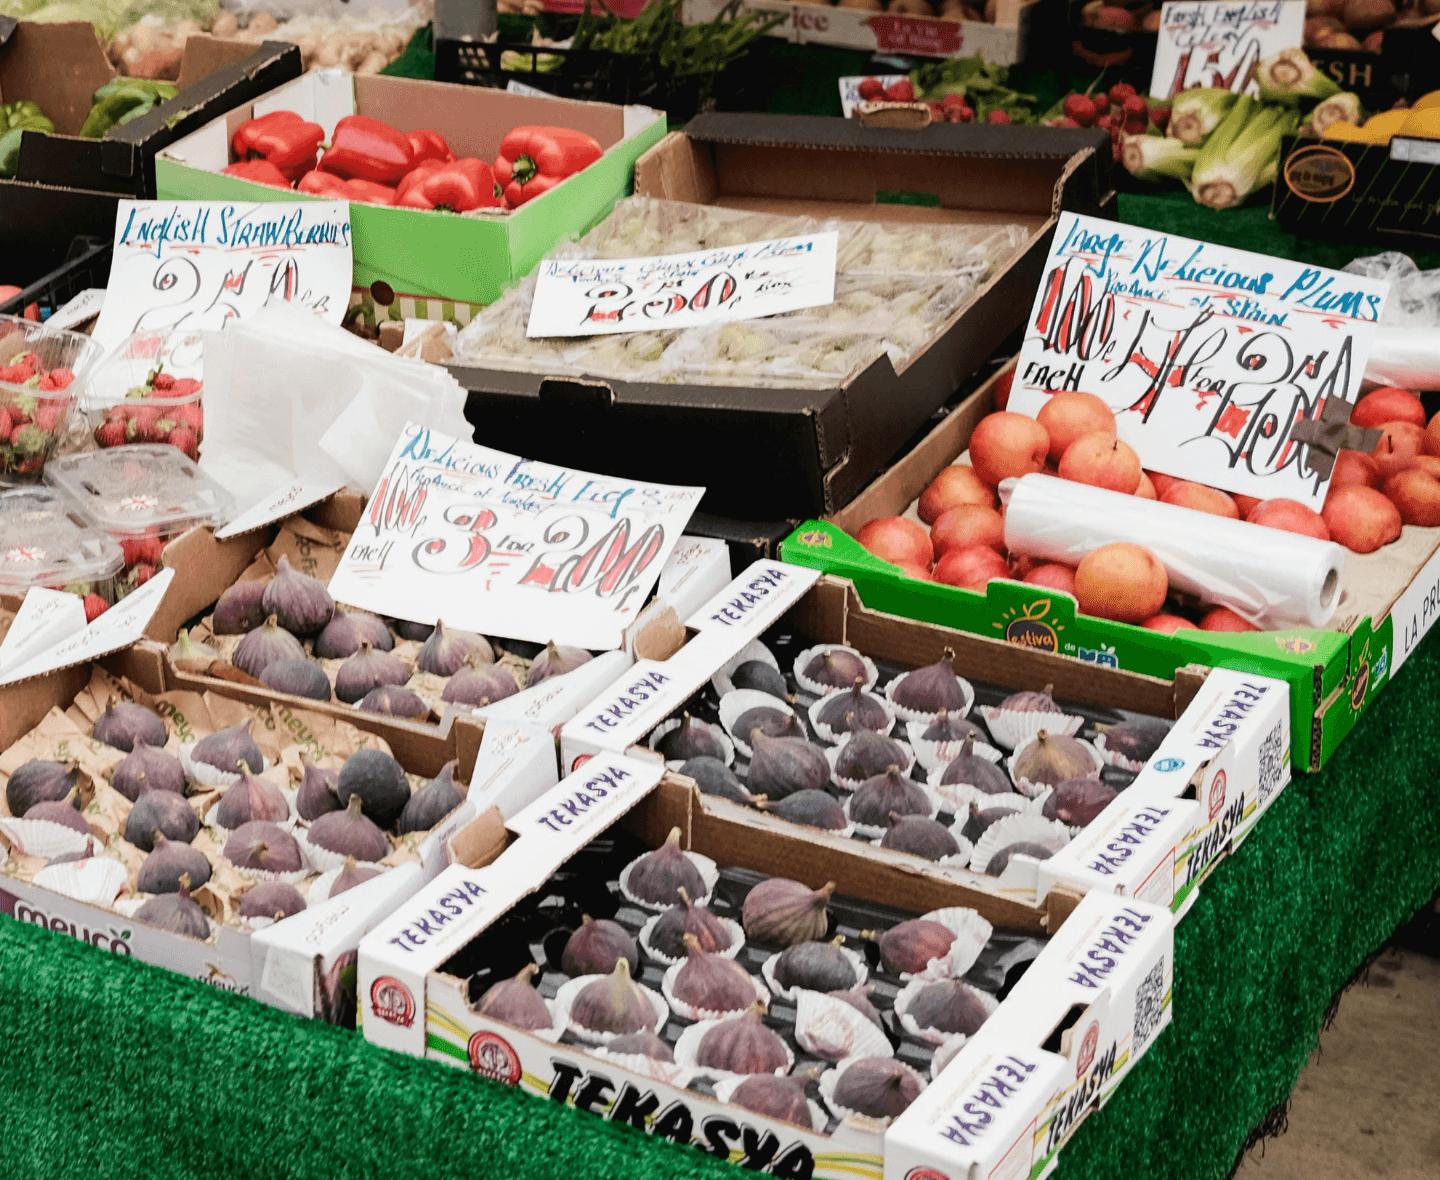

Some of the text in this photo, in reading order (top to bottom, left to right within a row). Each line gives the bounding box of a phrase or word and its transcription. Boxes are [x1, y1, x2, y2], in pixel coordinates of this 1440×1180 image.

[710, 567, 788, 627] TEKASYA
[1404, 613, 1418, 655] LA
[586, 671, 671, 734] TEKASYA
[1195, 682, 1270, 749] TEKASYA
[537, 765, 632, 833] TEKASYA
[1087, 806, 1170, 875] TEKASYA
[1186, 791, 1245, 887] TEKASYA
[388, 879, 487, 952] TEKASYA
[1067, 907, 1153, 989] TEKASYA
[547, 1056, 816, 1180] TEKASYA
[939, 1055, 1036, 1147] TEKASYA
[1045, 1039, 1118, 1155] TEKASYA
